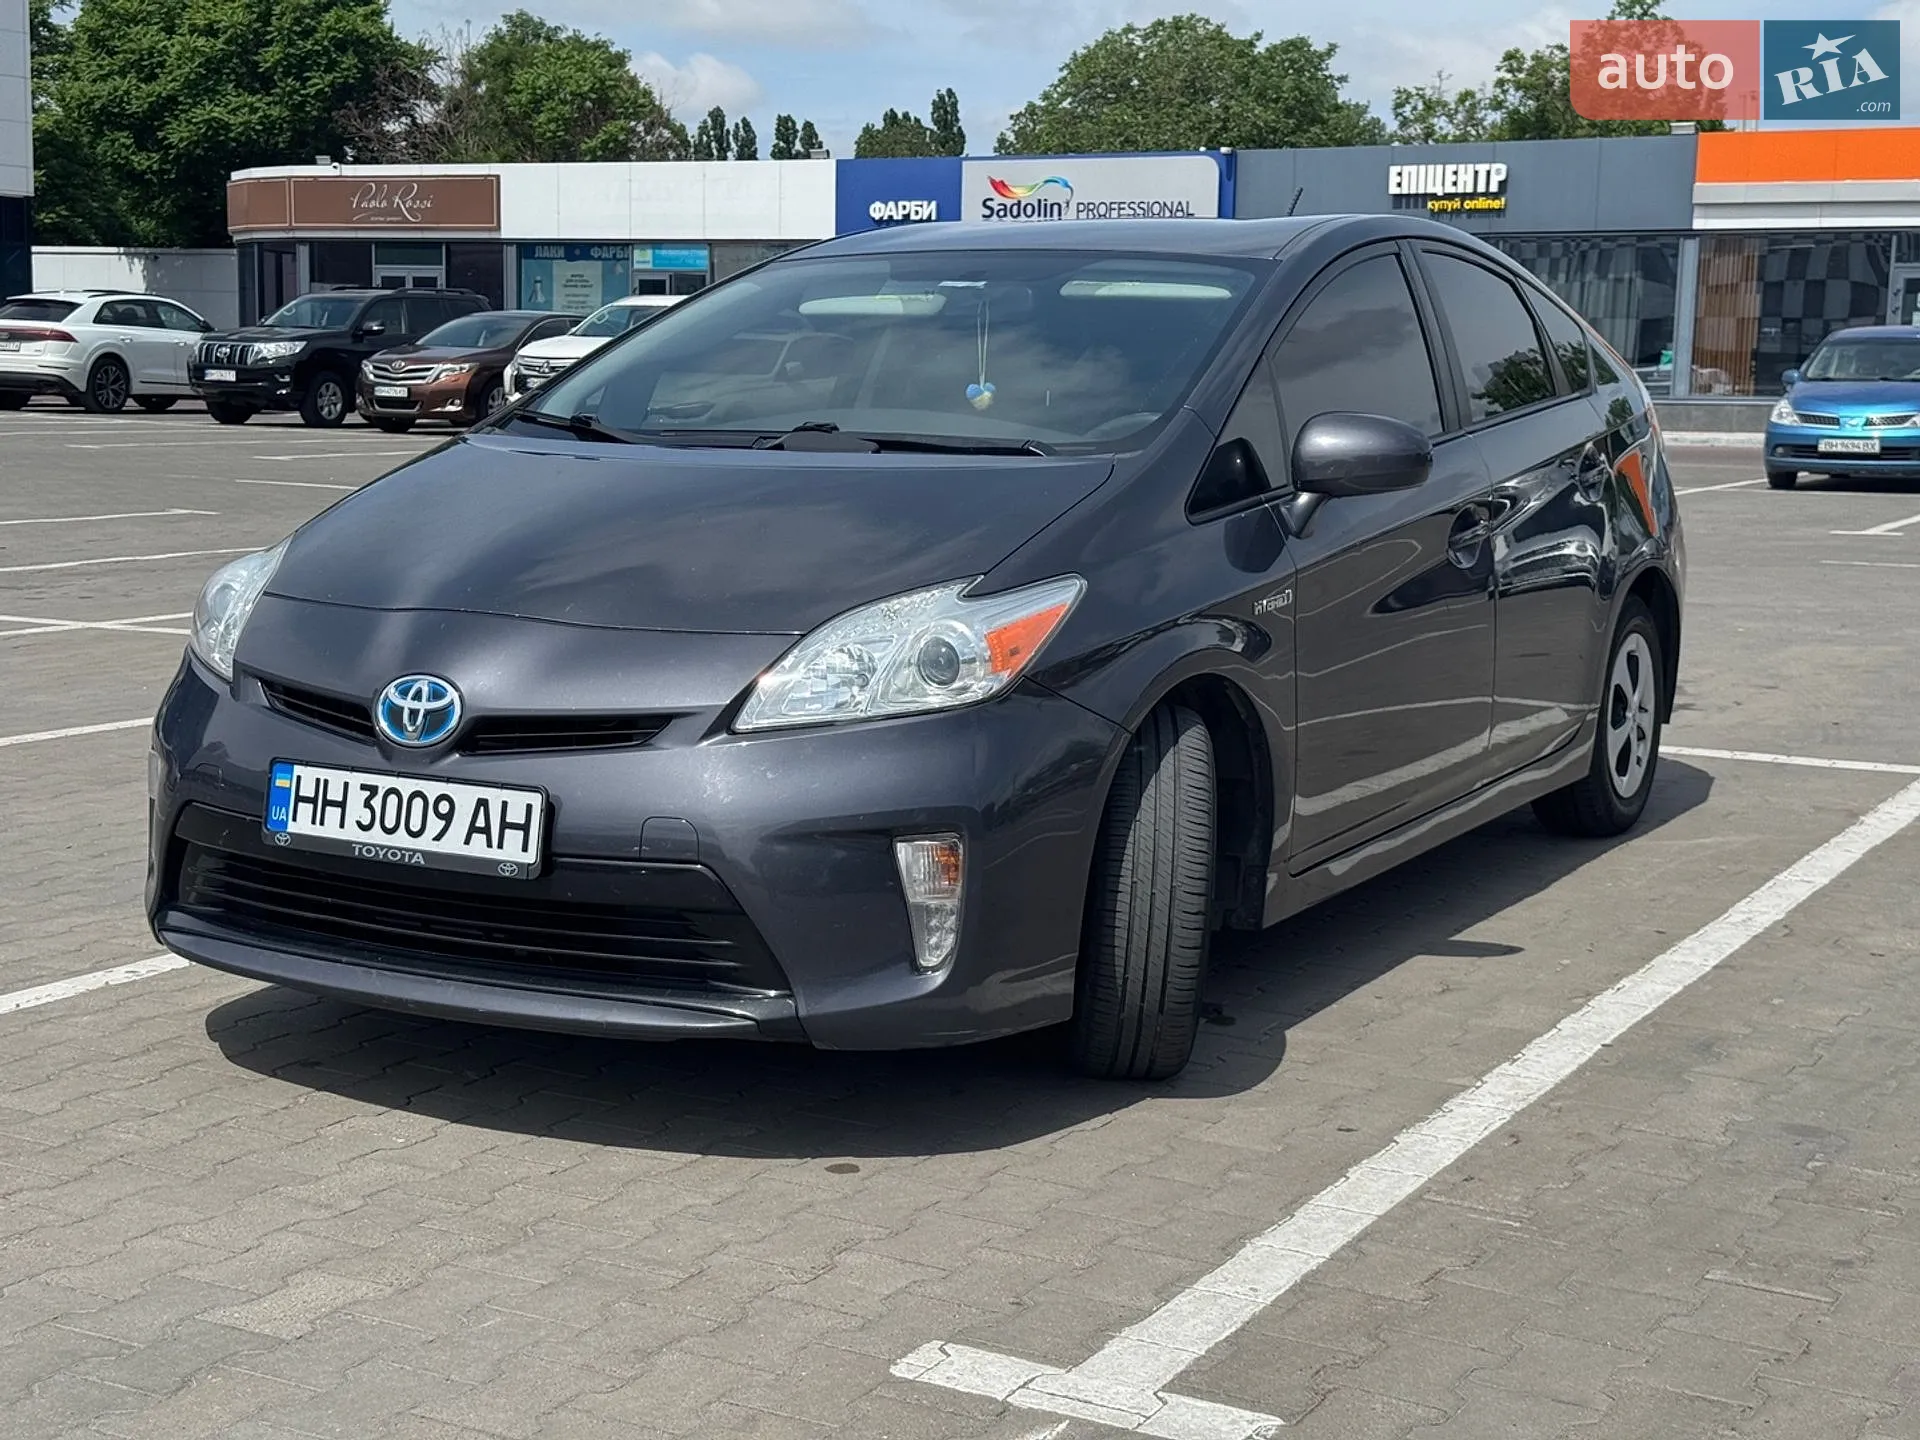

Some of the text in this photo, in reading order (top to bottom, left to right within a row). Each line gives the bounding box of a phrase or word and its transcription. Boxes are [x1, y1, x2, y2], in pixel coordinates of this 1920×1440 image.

[1388, 163, 1508, 196] ЕПІЦЕНТР
[350, 182, 434, 223] Paolo Rossi
[869, 200, 938, 222] ФАРБИ
[981, 197, 1195, 219] Sadolin PROFESSIONAL
[534, 245, 565, 259] ЛАКИ
[272, 805, 287, 821] UA
[291, 775, 533, 853] HH 3009 AH
[352, 844, 425, 865] TOYOTA
